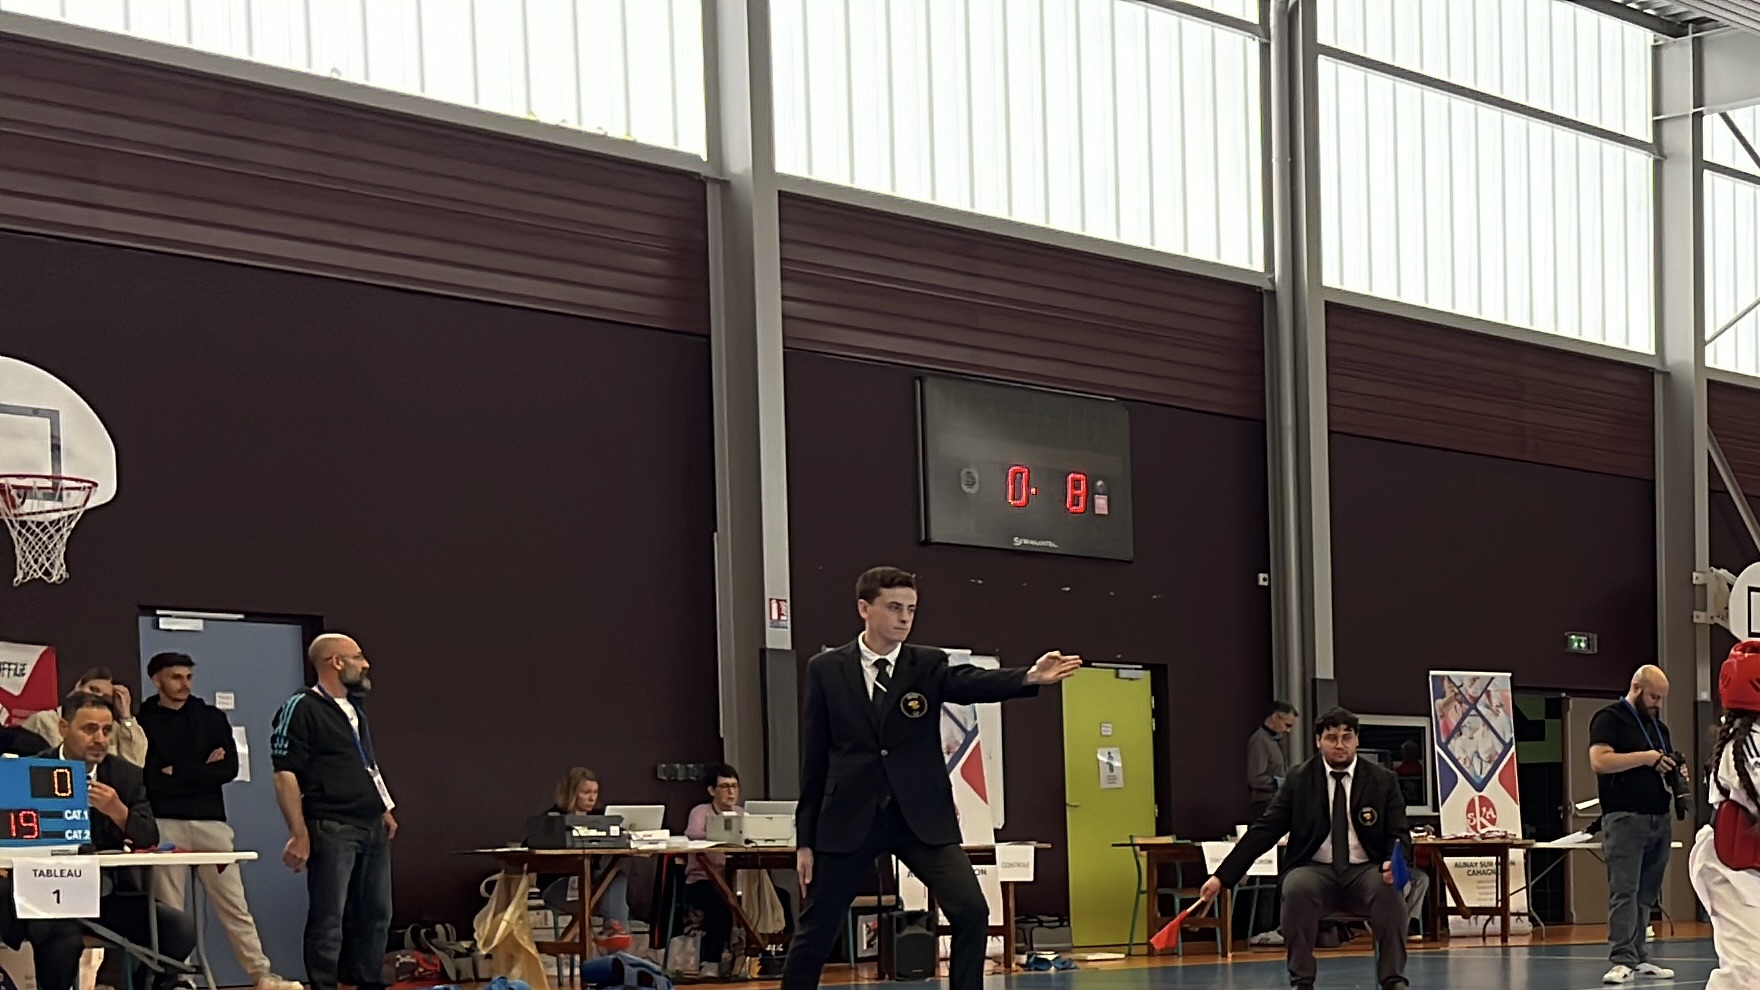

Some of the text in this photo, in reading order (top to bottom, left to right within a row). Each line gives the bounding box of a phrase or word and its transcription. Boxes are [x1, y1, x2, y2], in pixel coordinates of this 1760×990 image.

[53, 768, 73, 797] 0
[9, 811, 39, 839] 19
[32, 868, 83, 878] TABLEAU
[52, 889, 61, 905] 1
